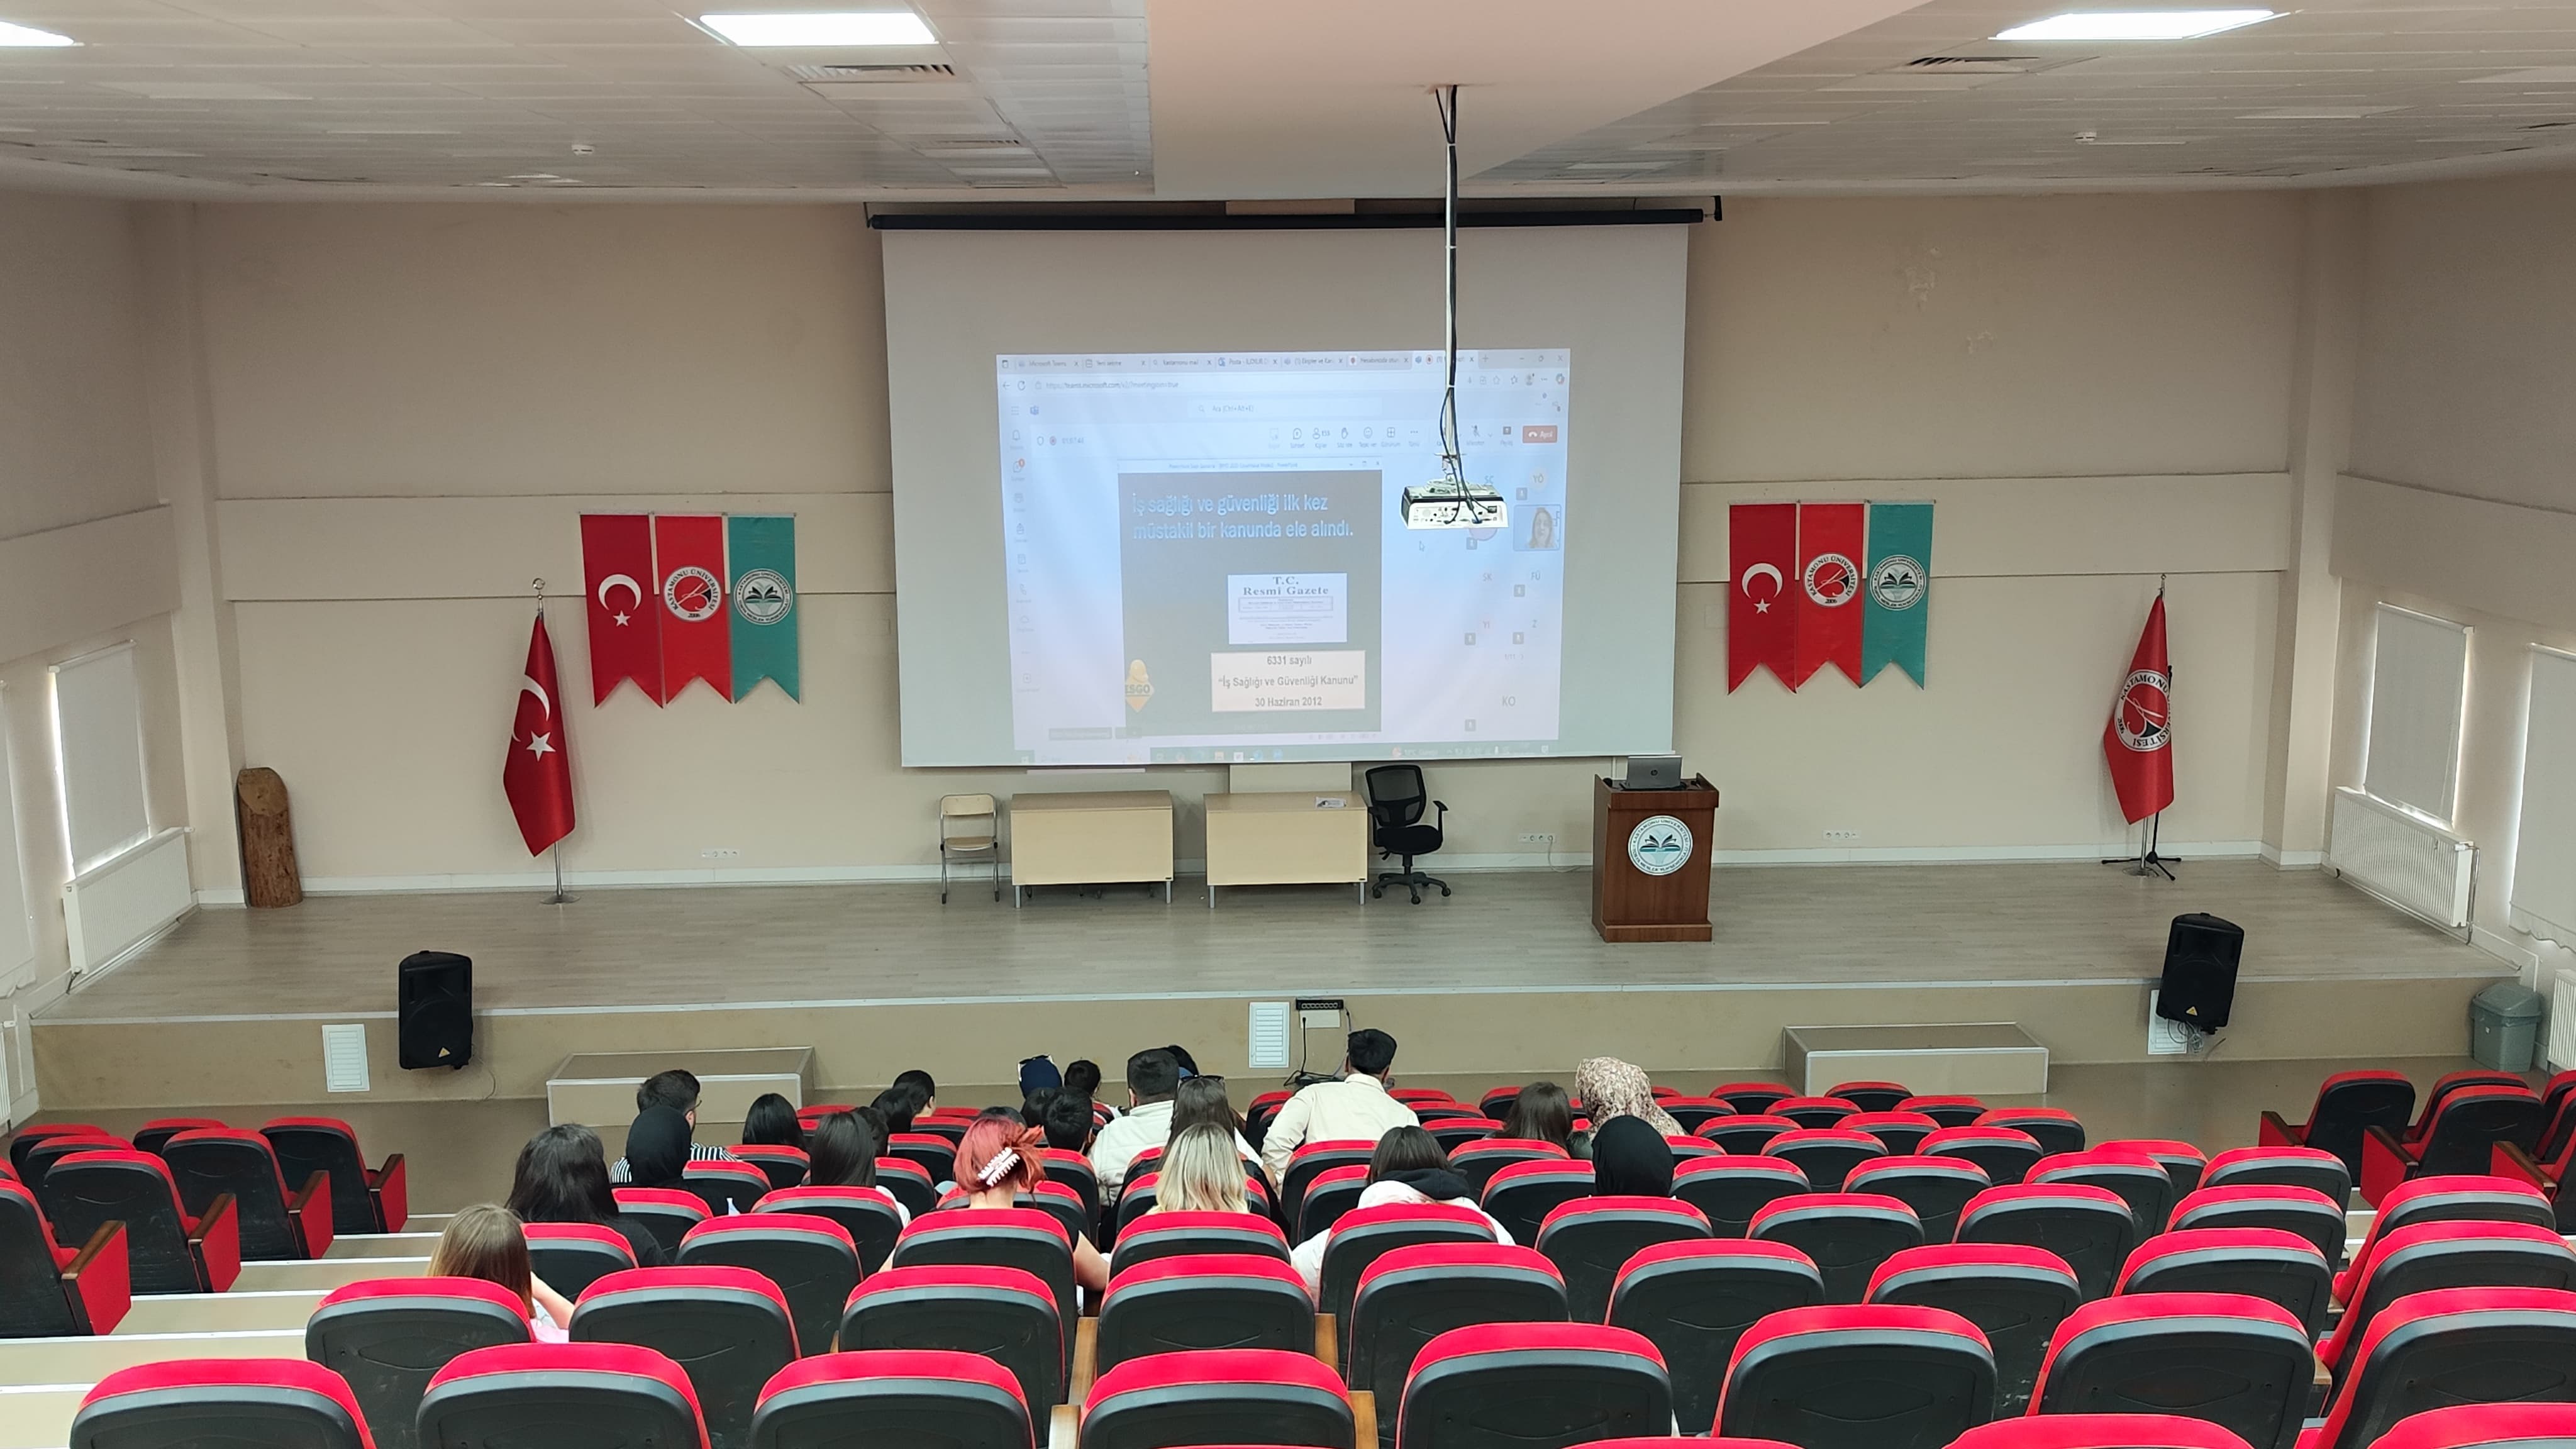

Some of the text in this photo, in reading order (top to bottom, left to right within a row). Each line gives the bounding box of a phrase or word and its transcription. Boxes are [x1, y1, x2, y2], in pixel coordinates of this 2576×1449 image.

[1132, 492, 1329, 516] İş sağlığı ve güvenliği ilk kez
[1133, 519, 1354, 539] müstakil bir kanunda ele alındı.
[1272, 575, 1299, 586] T.C.
[1286, 586, 1329, 596] Gazete
[1267, 655, 1313, 667] 6331 sayılı
[1233, 676, 1263, 689] Sağlığı
[1265, 678, 1275, 686] ve
[1277, 675, 1319, 688] Güvenliği
[1255, 696, 1323, 707] 30 Haziran 2012
